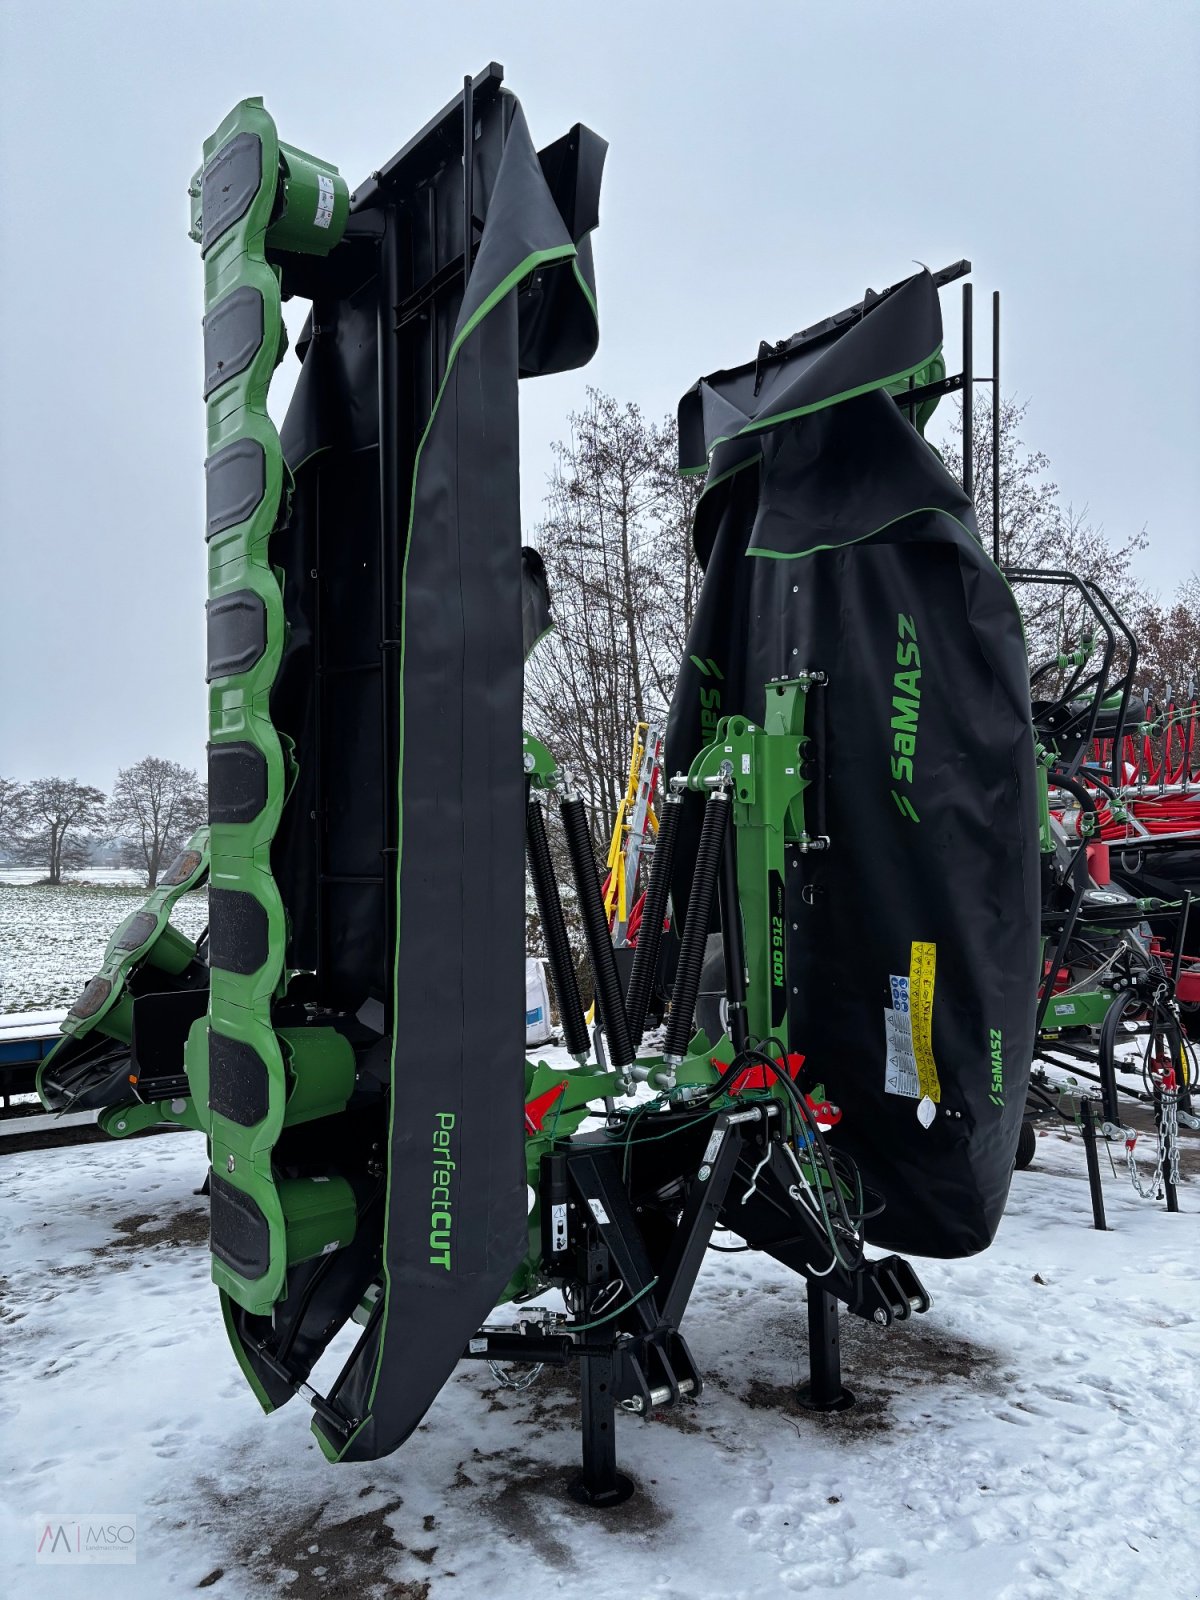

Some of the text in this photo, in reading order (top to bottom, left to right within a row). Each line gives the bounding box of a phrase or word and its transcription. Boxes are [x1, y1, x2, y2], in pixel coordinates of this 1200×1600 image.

[890, 613, 922, 784] SaMASZ
[772, 916, 784, 987] KDD 912
[989, 1028, 1003, 1093] SaMASZ
[429, 1112, 456, 1272] PerfectCUT
